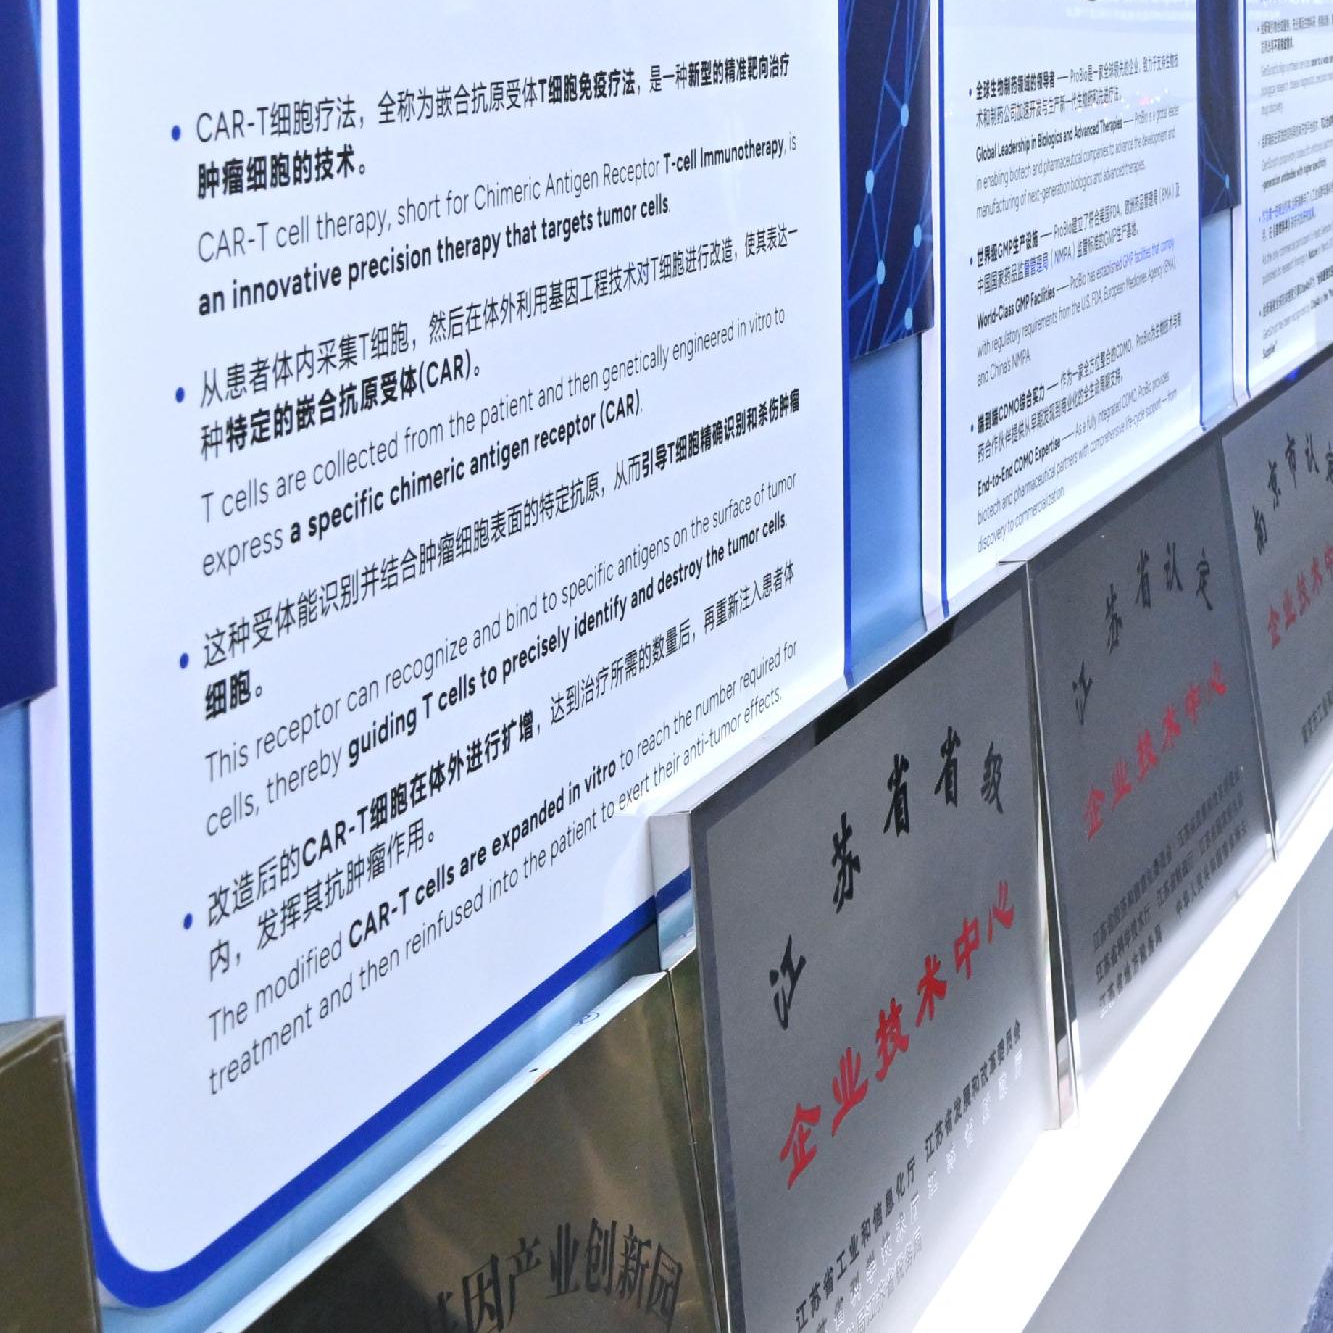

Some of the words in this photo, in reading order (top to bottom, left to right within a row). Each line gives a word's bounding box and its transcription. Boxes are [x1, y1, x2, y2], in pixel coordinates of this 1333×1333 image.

[197, 143, 365, 200] 肿瘤细胞的技术。
[198, 222, 269, 263] CAR-T
[276, 214, 309, 248] cell
[316, 210, 392, 240] therapy,
[398, 194, 441, 226] short
[446, 190, 469, 215] for
[474, 176, 540, 210] Chimeric
[546, 170, 598, 198] Antigen
[604, 158, 660, 186] Receptor
[663, 148, 696, 174] T-cell
[700, 139, 786, 168] Immunotherapy,
[788, 133, 798, 152] is
[976, 142, 996, 162] Global
[998, 136, 1030, 158] Leadership
[1074, 121, 1099, 141] Advanced
[198, 290, 225, 316] an
[232, 262, 342, 309] innovative
[348, 243, 431, 287] precision
[436, 232, 501, 263] therapy
[505, 220, 537, 248] that
[541, 210, 593, 241] targets
[596, 204, 637, 228] tumor
[640, 193, 670, 218] cells.
[977, 304, 1014, 330] World-Class
[1015, 294, 1030, 314] GMP
[1030, 286, 1055, 307] Facilities
[201, 492, 214, 523] T
[222, 478, 269, 517] cells
[276, 470, 306, 498] are
[312, 431, 398, 485] collected
[404, 423, 443, 453] from
[449, 410, 475, 438] the
[481, 388, 533, 432] patient
[538, 378, 563, 408] and
[568, 371, 598, 397] then
[603, 344, 669, 390] genetically
[672, 321, 733, 361] engineered
[738, 318, 746, 338] in
[749, 313, 772, 334] vitro
[774, 307, 785, 325] to
[978, 464, 1013, 497] End-to-End
[1014, 450, 1033, 474] CDMO
[1035, 437, 1060, 462] Expertise
[204, 671, 262, 721] 细胞。
[206, 792, 259, 837] cells,
[266, 746, 342, 804] thereby
[348, 707, 417, 764] guiding
[422, 691, 433, 719] T
[438, 673, 476, 712] cells
[480, 666, 497, 689] to
[502, 625, 570, 682] precisely
[574, 595, 628, 640] identify
[631, 578, 654, 609] and
[657, 556, 702, 595] destroy
[706, 546, 724, 568] the
[728, 526, 759, 556] tumor
[762, 514, 787, 538] cells.
[1084, 657, 1228, 841] 企业技术中心
[210, 823, 434, 982] 内，发挥其抗肿瘤作用。
[778, 879, 1017, 1191] 企业技术中心
[425, 1217, 684, 1333] 因产业创新园
